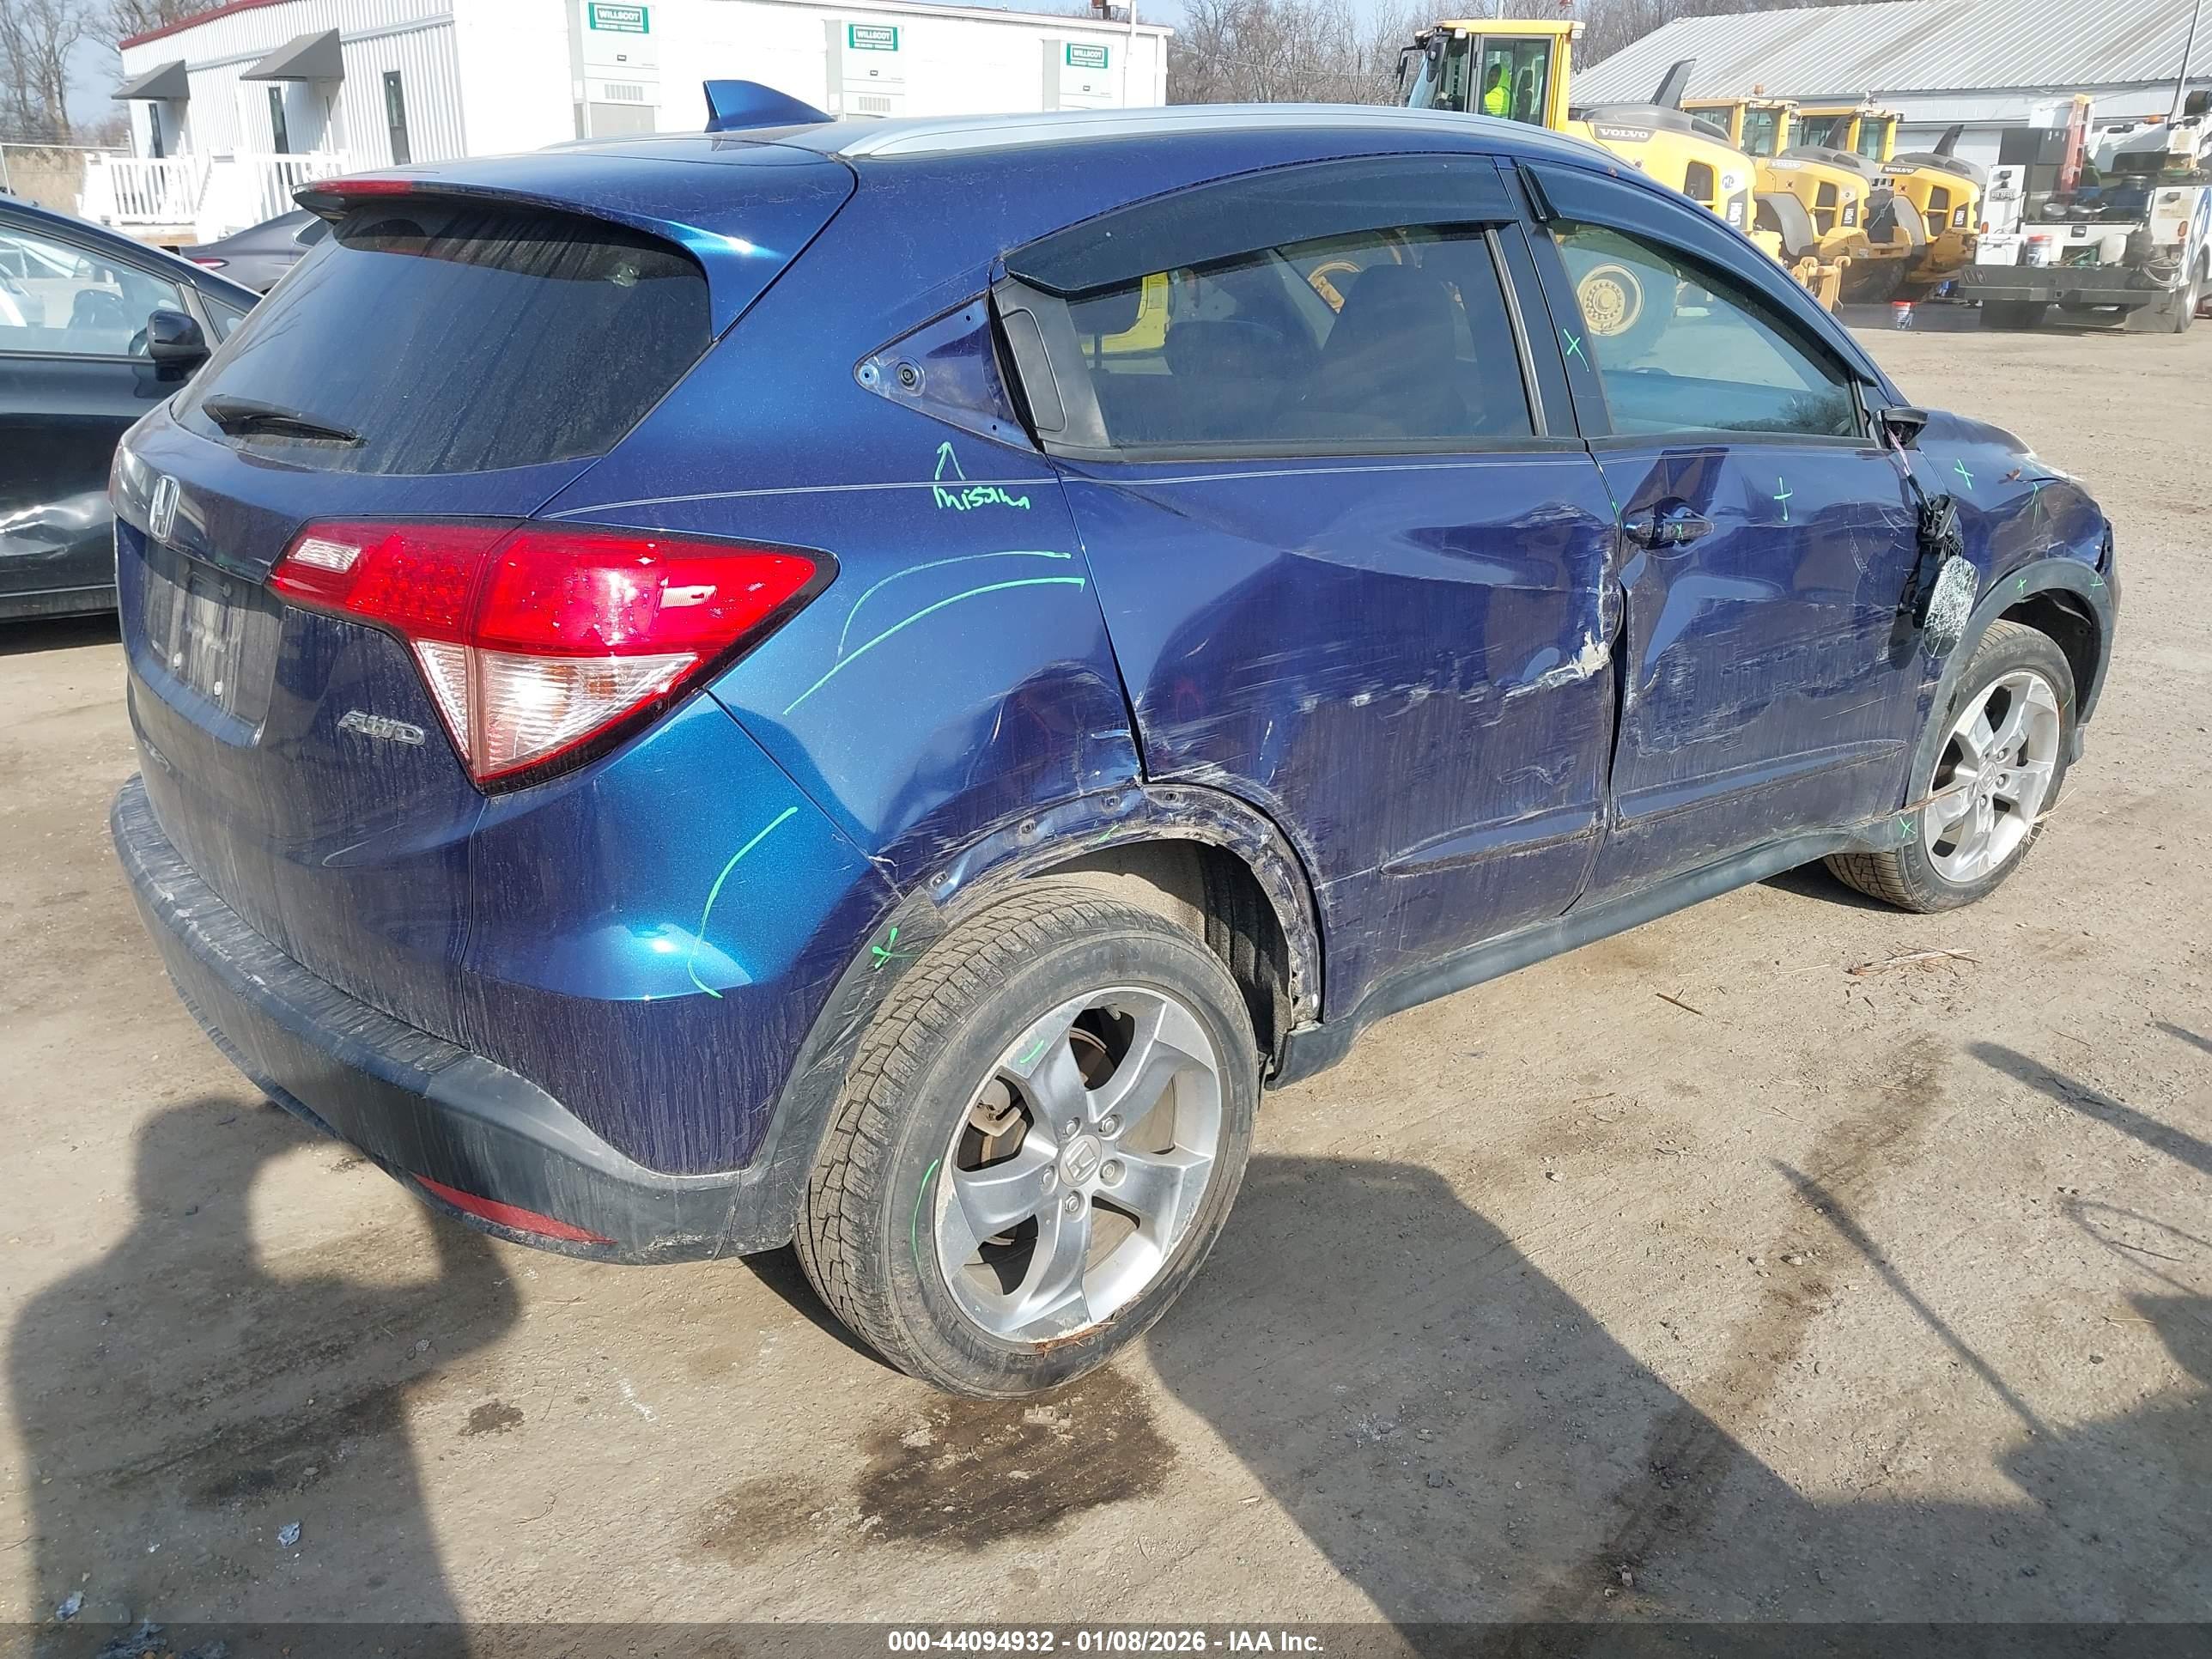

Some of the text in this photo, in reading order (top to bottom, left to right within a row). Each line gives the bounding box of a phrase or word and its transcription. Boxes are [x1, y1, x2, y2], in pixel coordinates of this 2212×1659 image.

[598, 9, 640, 21] WILLSCOT
[857, 29, 890, 41] WILLSCOT
[1598, 128, 1649, 139] VOLVO
[337, 709, 426, 746] AWD
